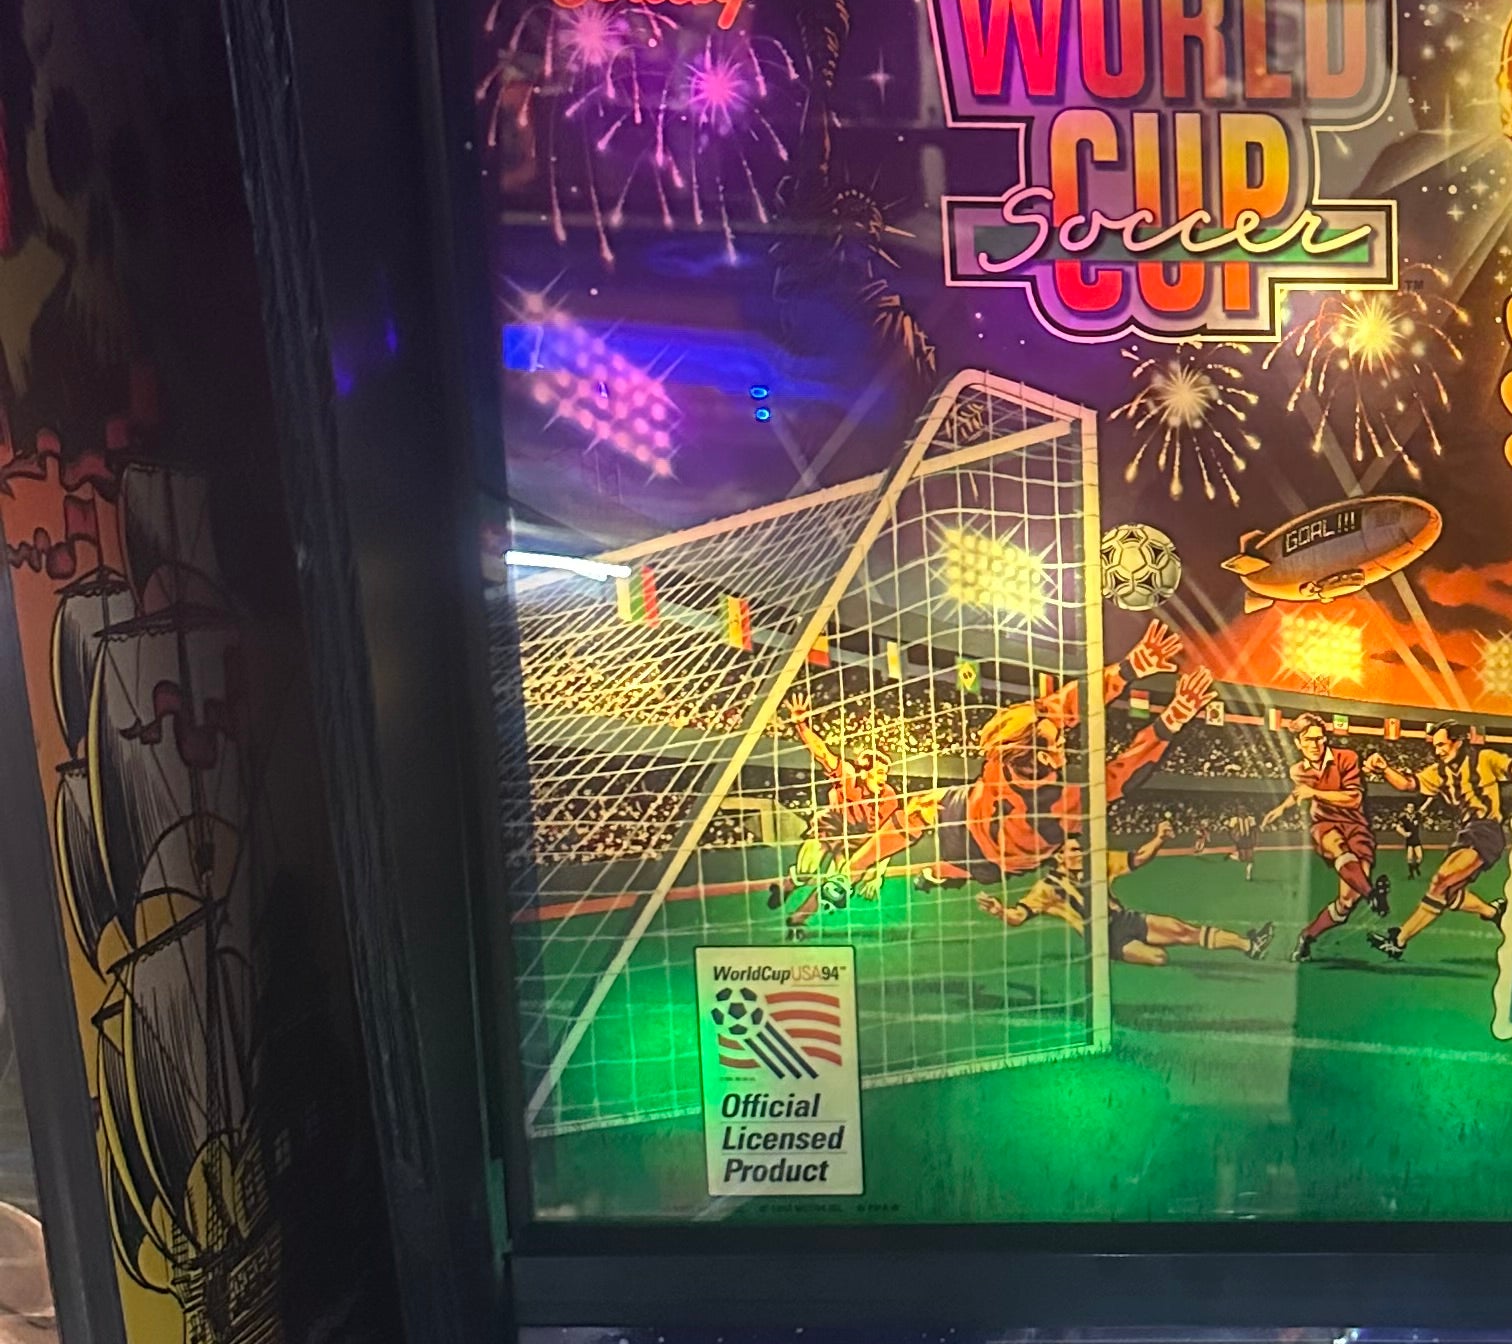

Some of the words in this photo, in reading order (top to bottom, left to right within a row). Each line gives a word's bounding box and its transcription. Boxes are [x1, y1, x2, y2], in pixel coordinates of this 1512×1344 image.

[1050, 108, 1290, 312] CUP
[978, 186, 1371, 273] Soccer
[720, 1093, 821, 1118] Official
[721, 1125, 846, 1151] Licensed
[723, 1158, 830, 1183] Product
